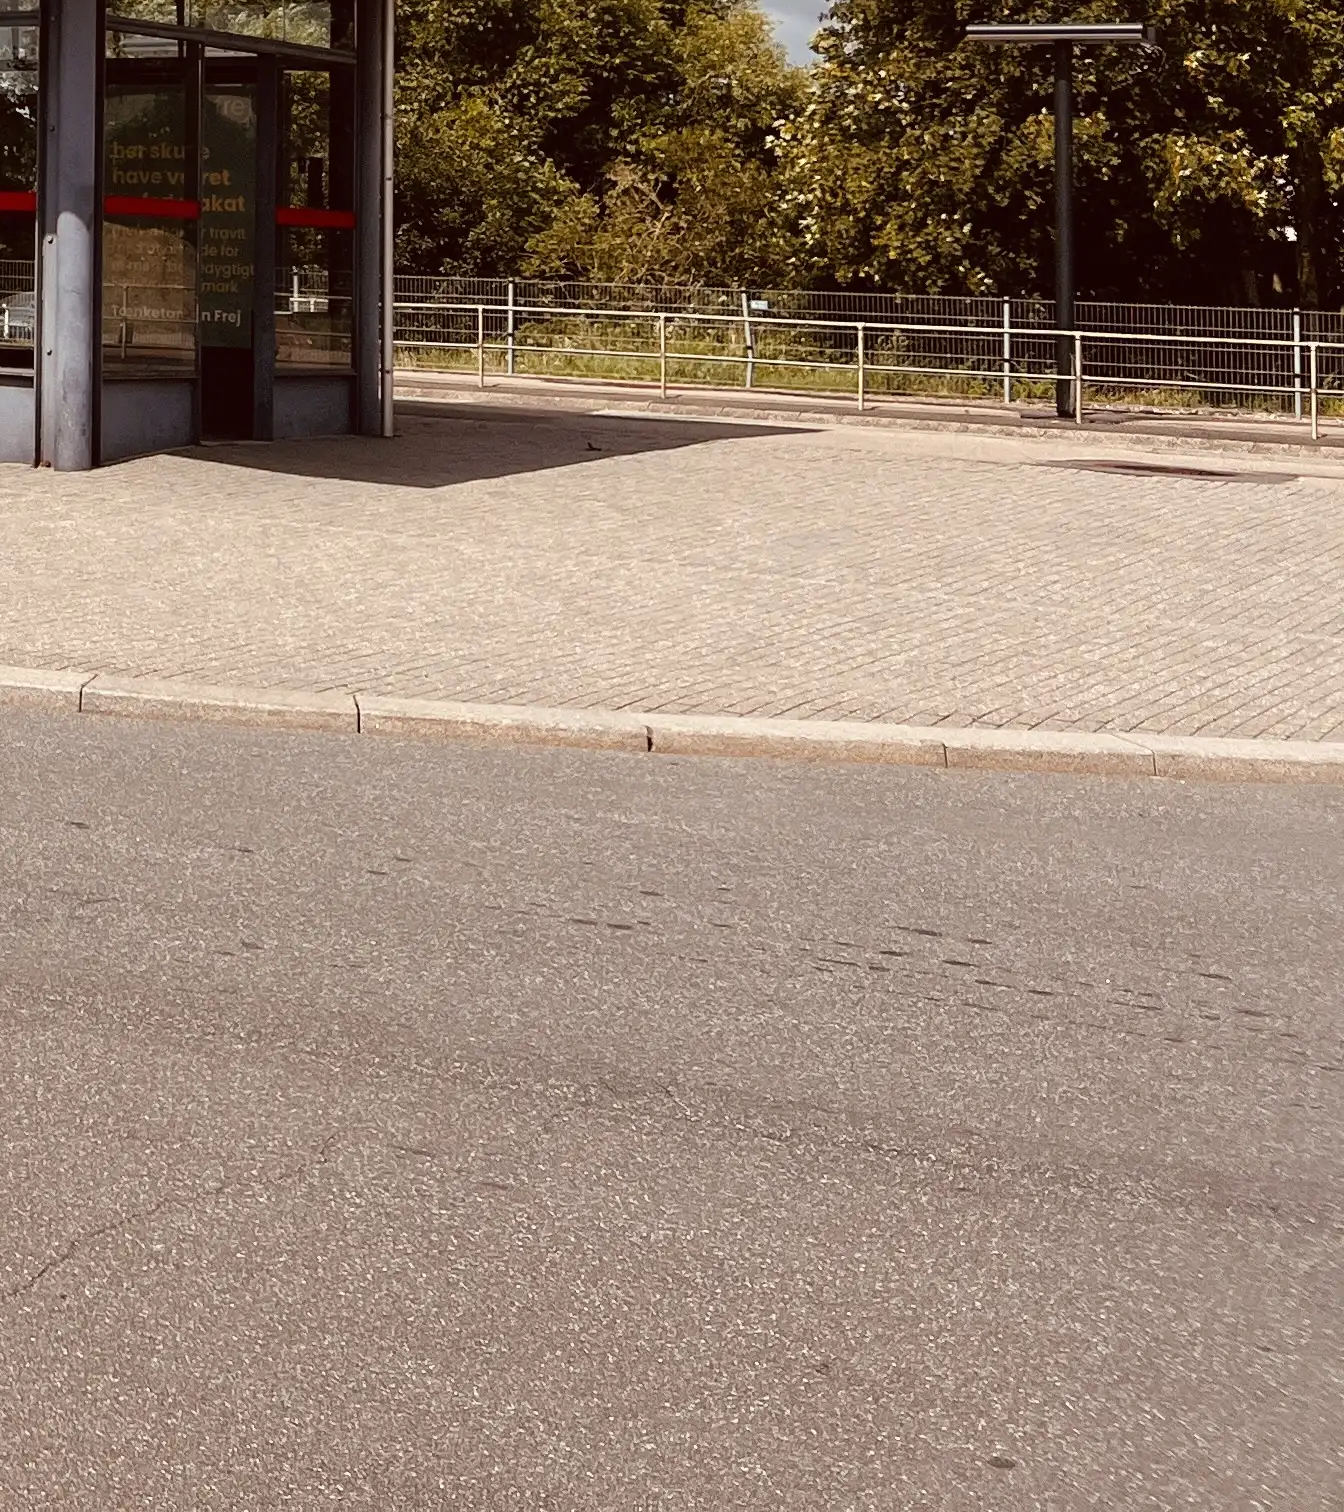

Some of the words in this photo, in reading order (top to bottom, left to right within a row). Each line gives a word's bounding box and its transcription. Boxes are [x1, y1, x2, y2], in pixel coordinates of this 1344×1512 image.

[150, 142, 210, 160] skue
[167, 169, 231, 186] vret
[214, 309, 241, 327] Frej
